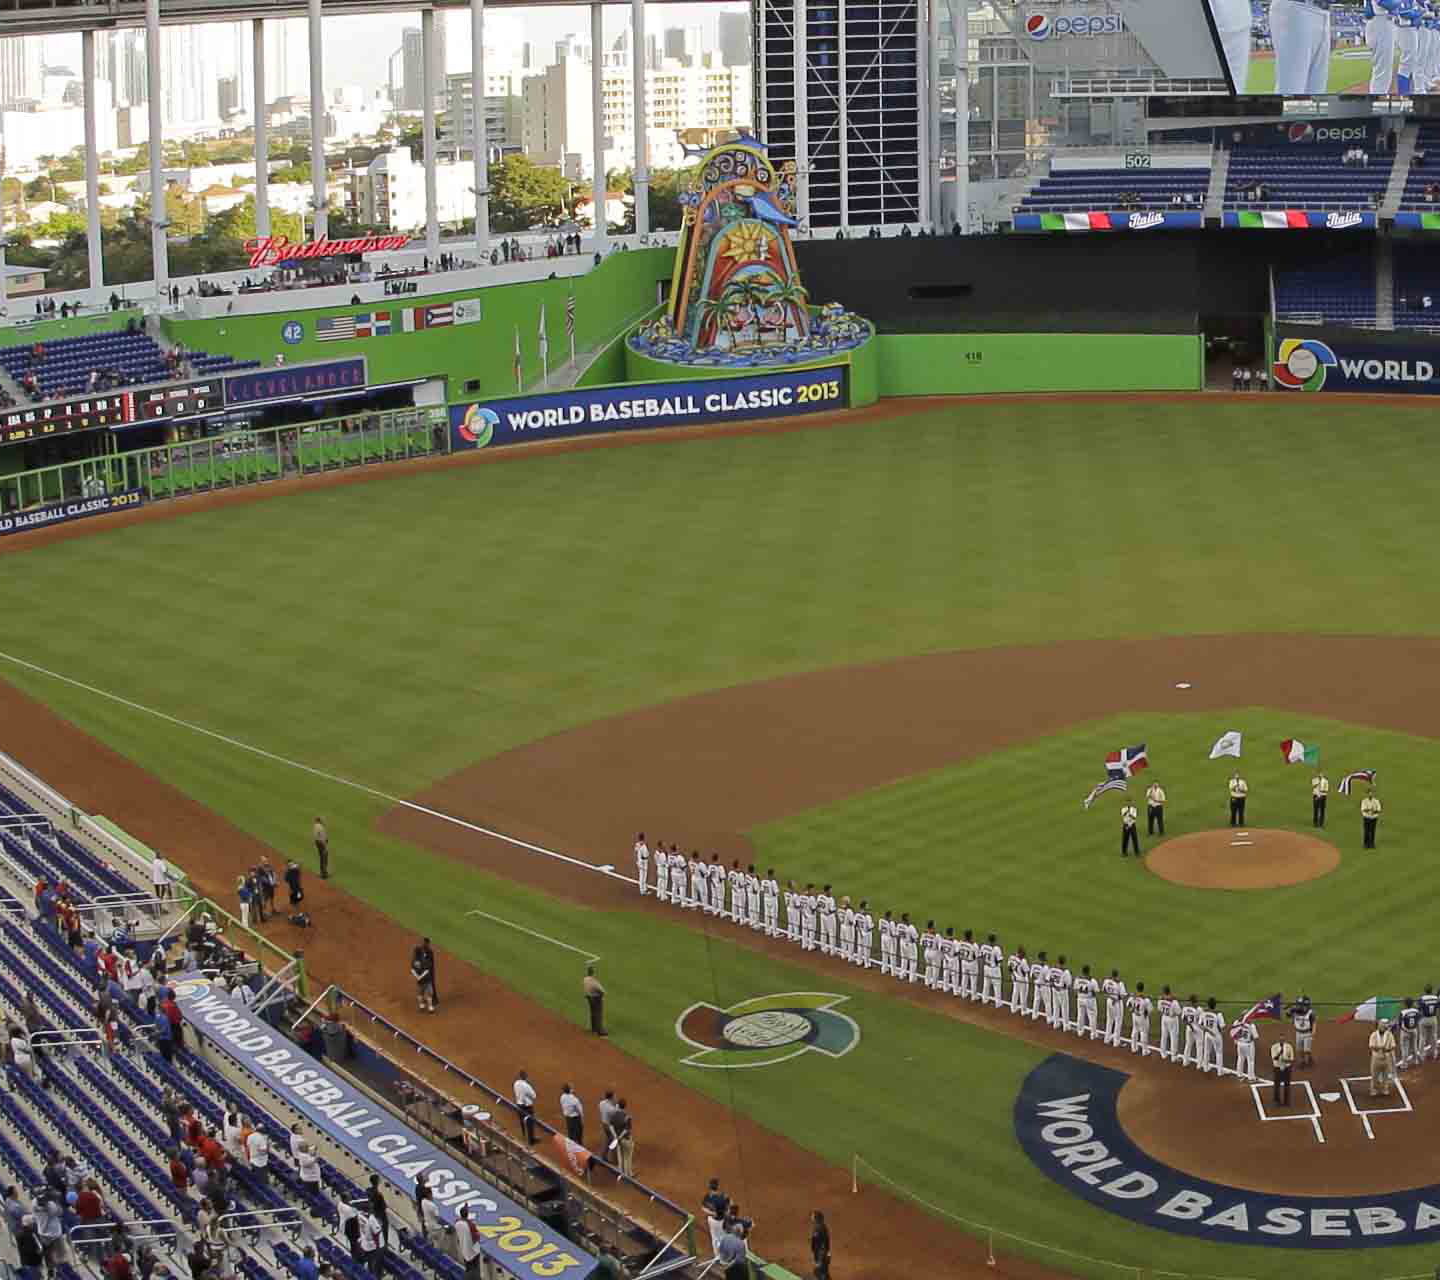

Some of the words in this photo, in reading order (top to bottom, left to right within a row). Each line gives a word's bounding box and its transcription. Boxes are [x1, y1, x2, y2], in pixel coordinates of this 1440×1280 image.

[1055, 13, 1122, 36] pepsi
[1315, 126, 1367, 141] pepsi
[1126, 154, 1151, 168] 502
[1128, 212, 1165, 229] Italia
[1326, 212, 1363, 229] Italia
[243, 233, 413, 269] Budweiser
[283, 326, 302, 340] 42
[1340, 358, 1434, 382] WORLD
[155, 405, 163, 416] 0
[177, 402, 184, 412] 0
[198, 399, 205, 409] 0
[508, 405, 586, 431] WORLD
[590, 395, 701, 422] BASEBALL
[705, 387, 793, 413] CLASSIC
[796, 381, 840, 403] 2013
[15, 507, 66, 528] BASEBALL
[67, 498, 110, 516] CLASSIC
[111, 491, 140, 507] 2013
[191, 994, 274, 1053] WORLD
[257, 1049, 373, 1139] BASEBALL
[368, 1133, 499, 1220] CLASSIC
[477, 1216, 582, 1277] 2013
[1037, 1092, 1160, 1201] WORLD
